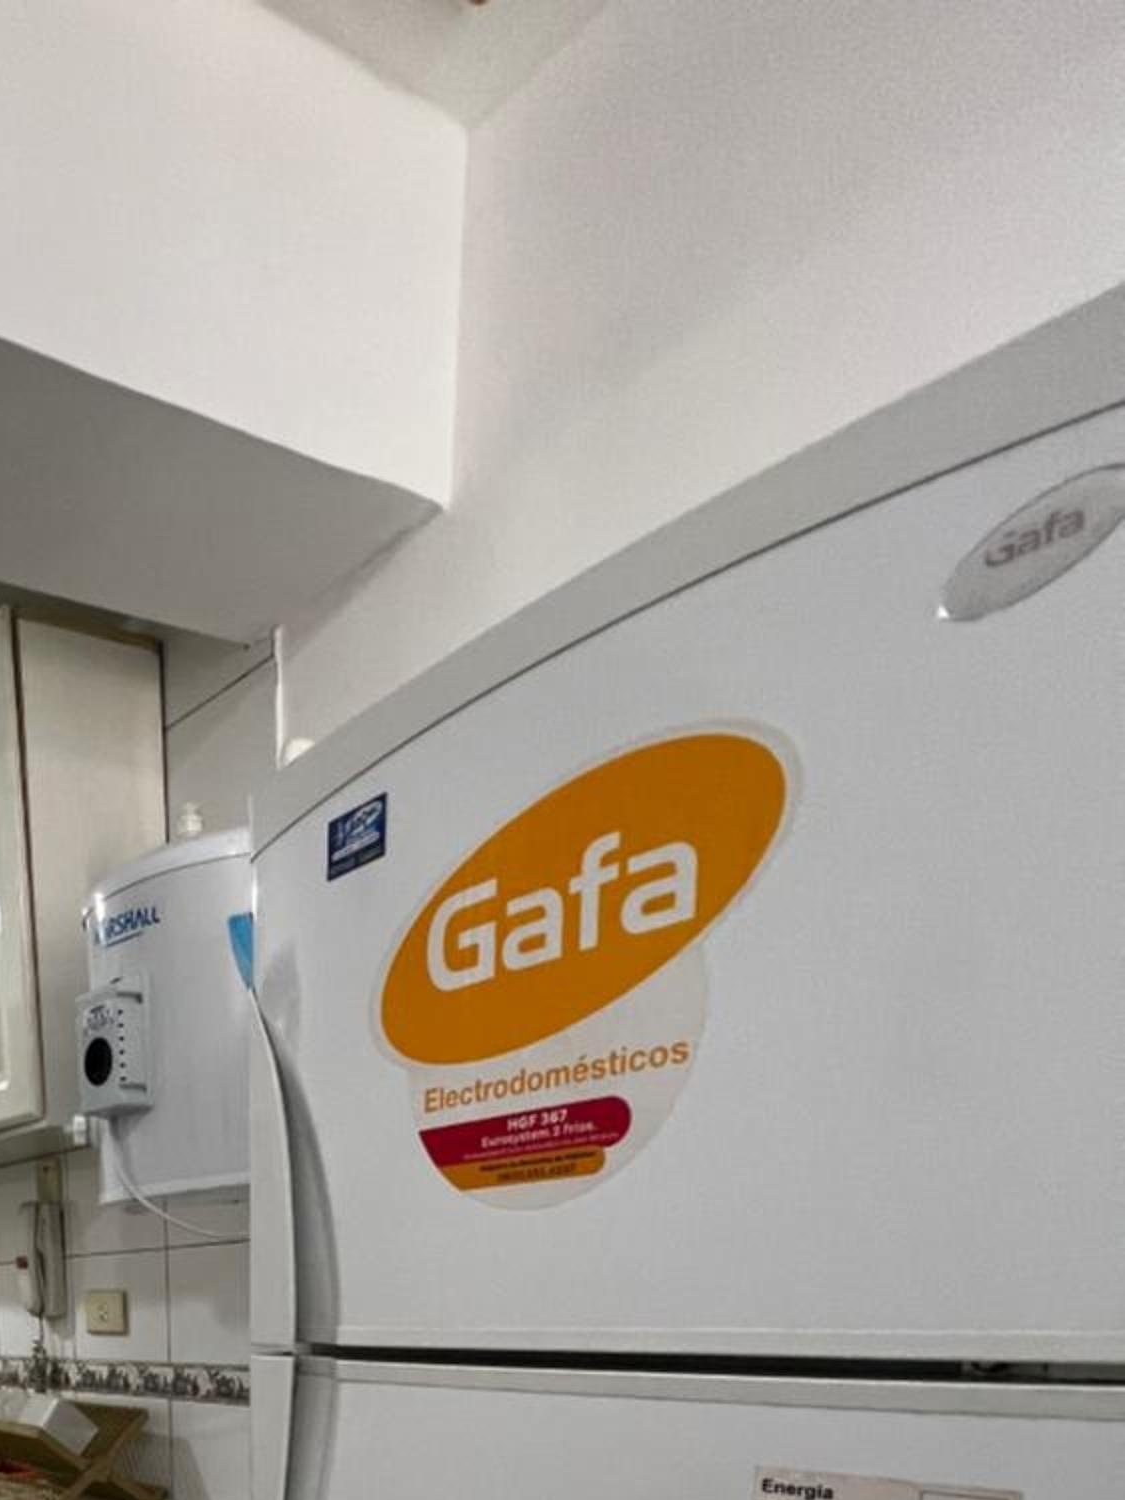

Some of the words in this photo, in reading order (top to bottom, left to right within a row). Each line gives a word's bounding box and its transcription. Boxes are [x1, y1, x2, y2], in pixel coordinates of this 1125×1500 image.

[985, 509, 1085, 567] Gafa
[426, 831, 699, 992] Gafa
[423, 1038, 690, 1114] Electrodomésticos
[507, 1115, 537, 1132] HGF
